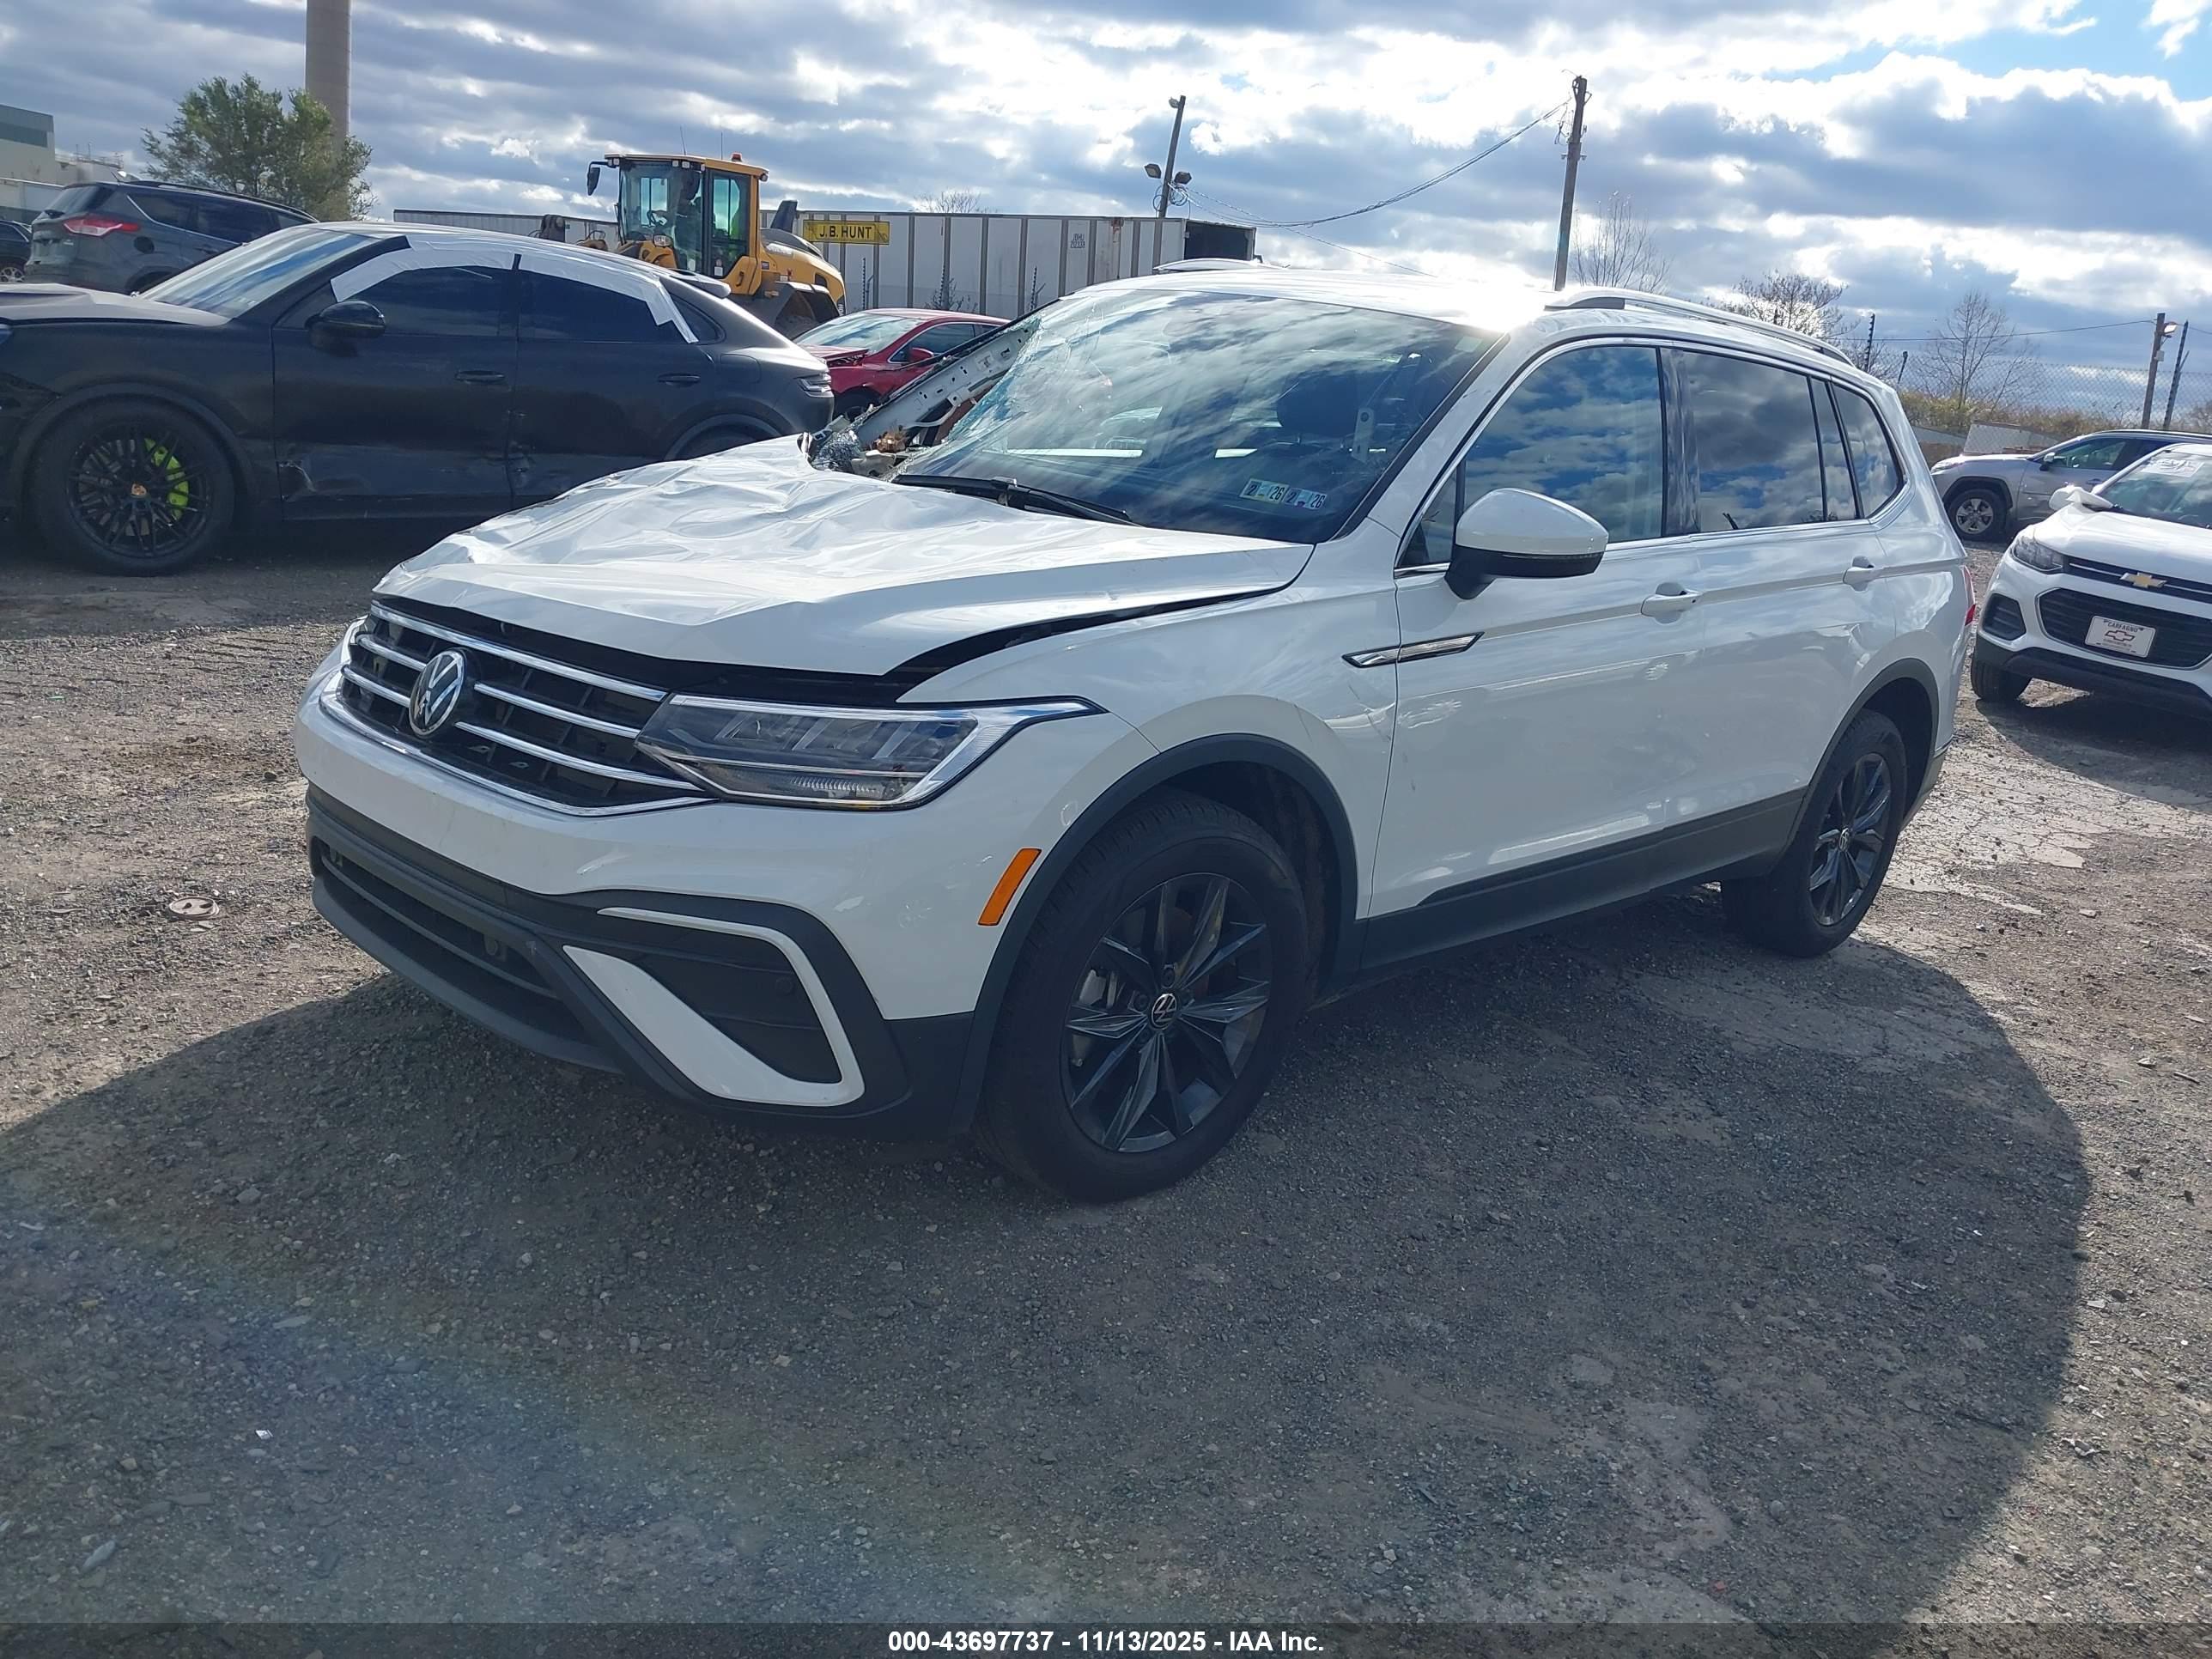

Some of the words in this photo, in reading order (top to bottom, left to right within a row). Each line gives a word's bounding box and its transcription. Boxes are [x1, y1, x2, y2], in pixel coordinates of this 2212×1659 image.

[841, 226, 872, 239] HUNT
[1247, 483, 1258, 496] 2
[1269, 485, 1285, 500] 26
[1310, 494, 1326, 508] 26
